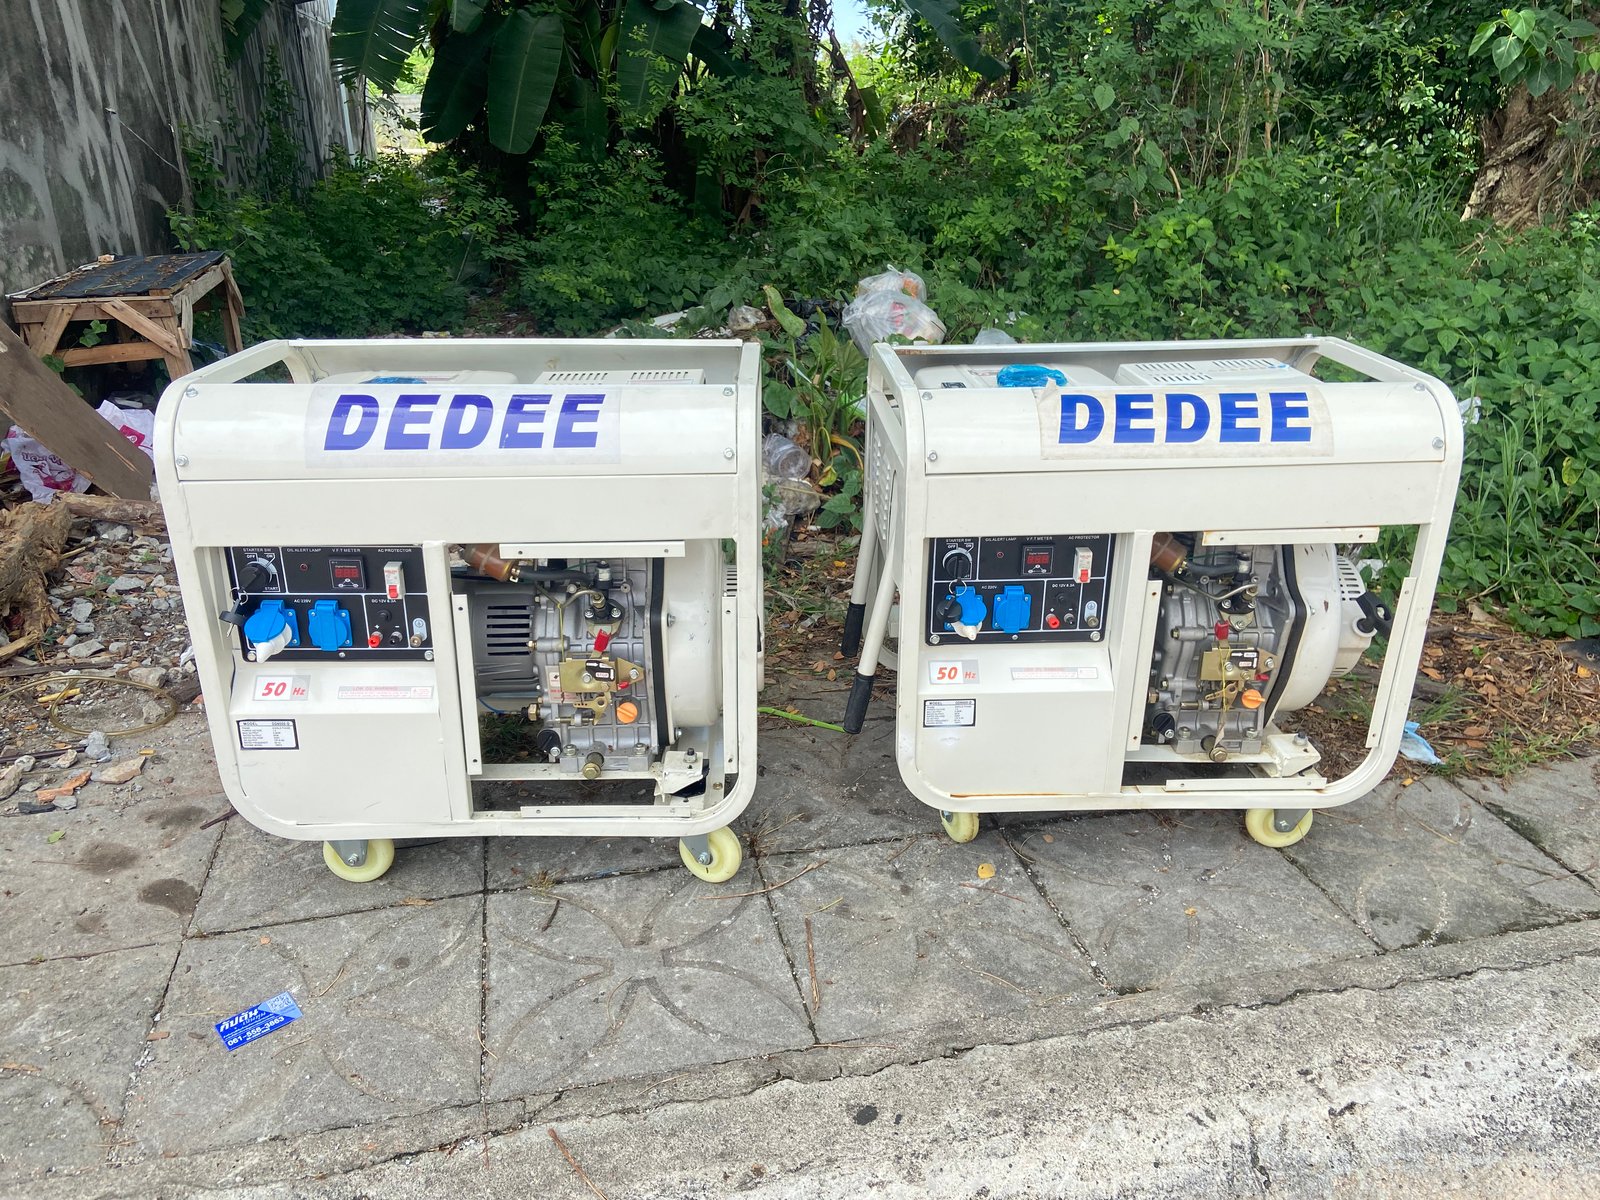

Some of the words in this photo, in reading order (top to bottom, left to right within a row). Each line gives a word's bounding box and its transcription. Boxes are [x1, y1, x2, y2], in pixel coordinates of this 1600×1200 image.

[324, 394, 606, 451] DEDEE
[1058, 392, 1312, 444] DEDEE
[262, 682, 287, 696] 50
[292, 688, 306, 696] Hz
[936, 666, 958, 680] 50
